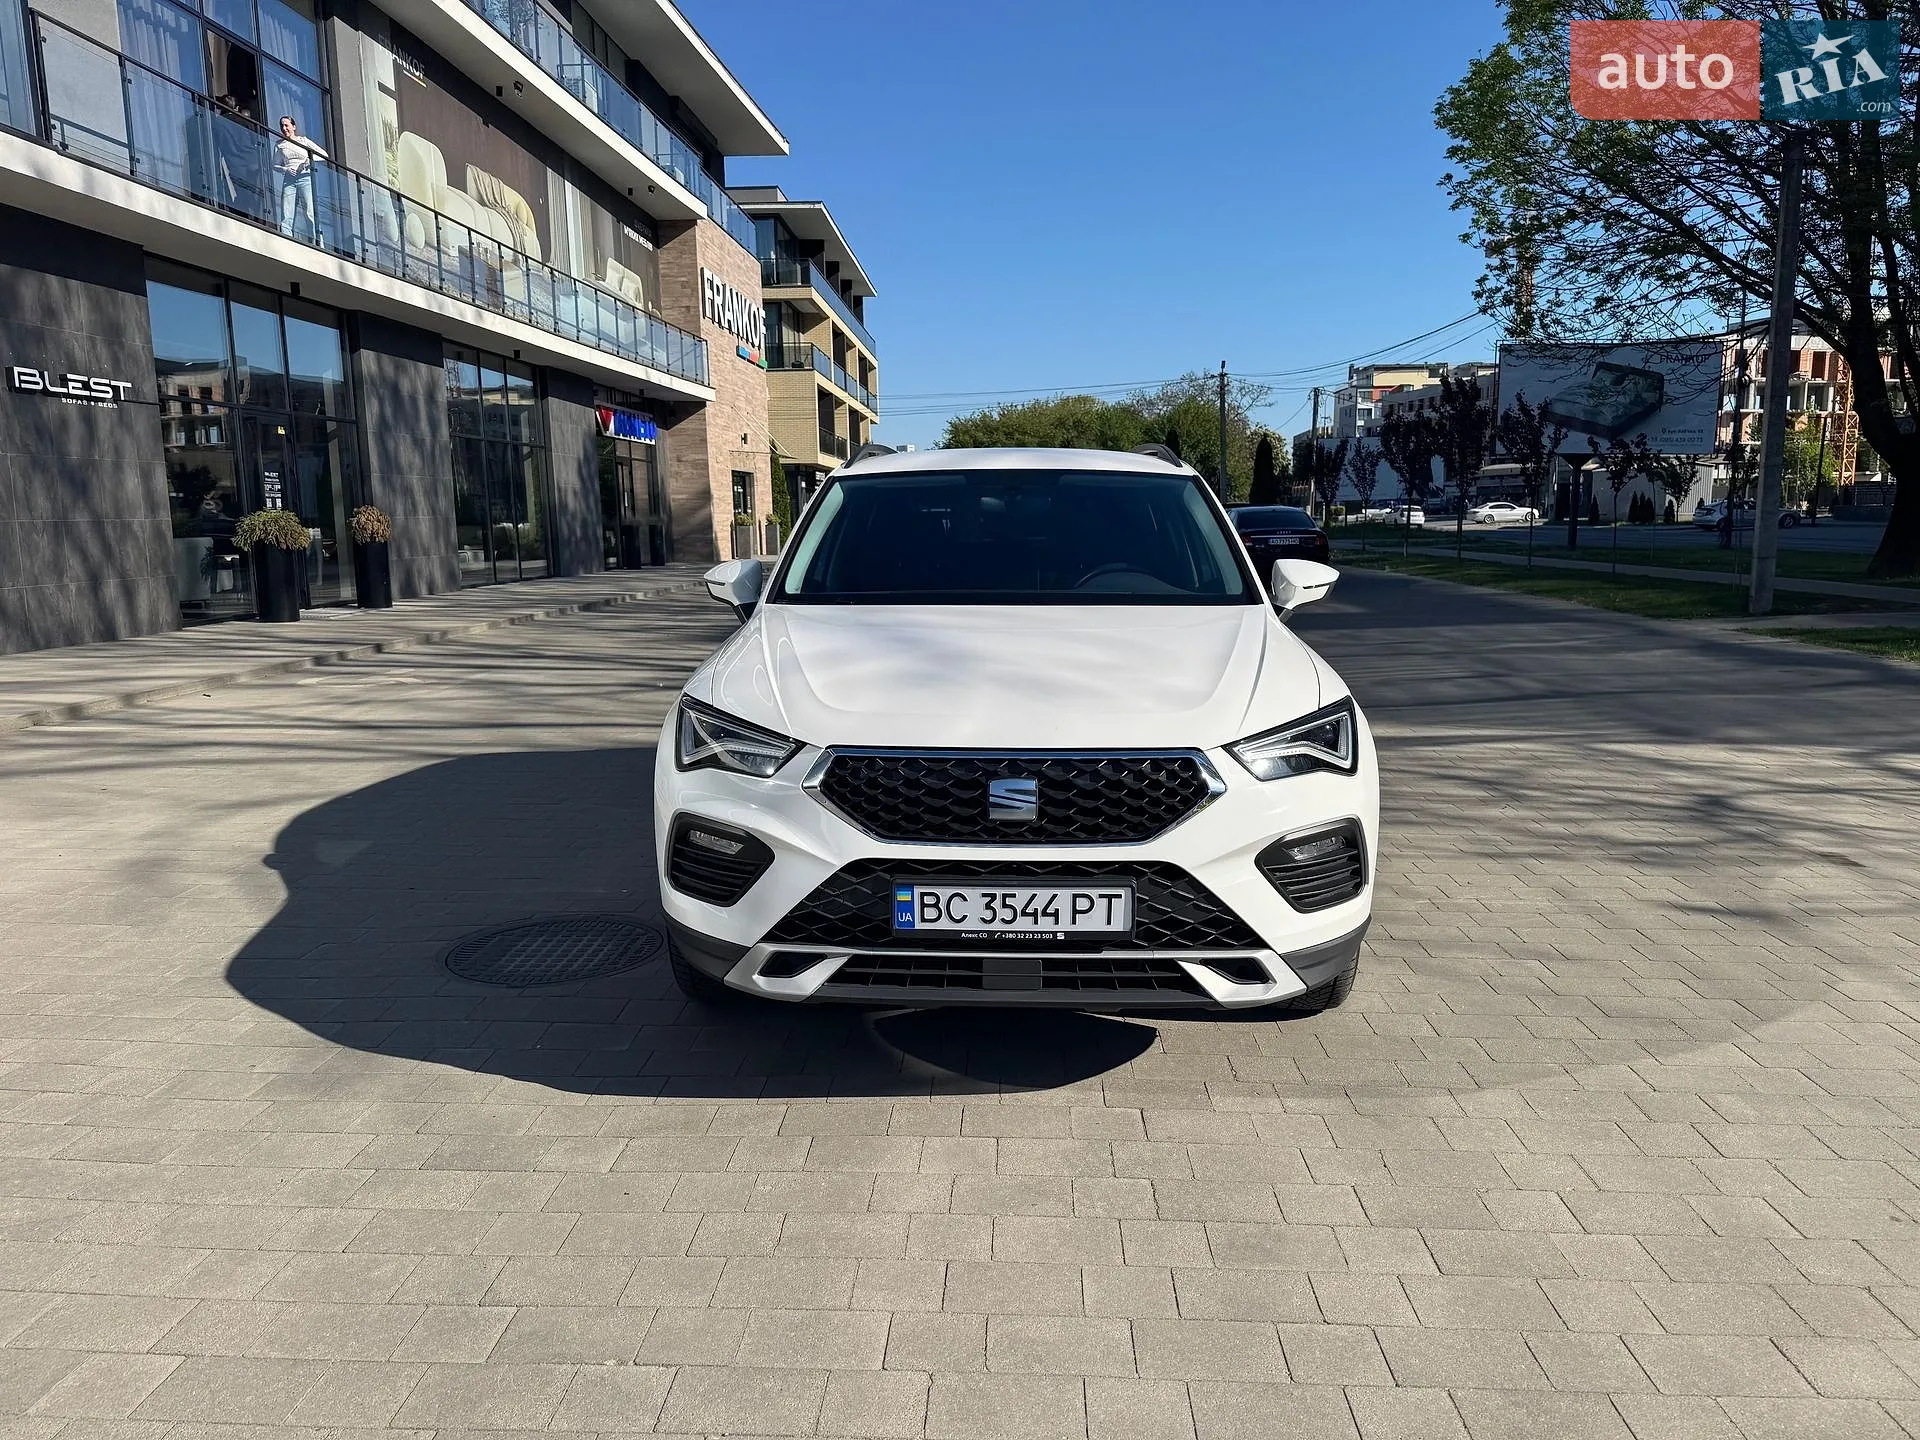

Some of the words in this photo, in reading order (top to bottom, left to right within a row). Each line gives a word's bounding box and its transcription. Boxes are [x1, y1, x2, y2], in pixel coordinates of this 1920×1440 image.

[702, 267, 767, 350] FRANKOF
[13, 366, 133, 401] BLEST
[61, 397, 88, 406] SOFAS
[898, 913, 913, 922] UA
[920, 891, 969, 924] BC
[979, 892, 1060, 925] 3544
[1071, 893, 1123, 926] PT
